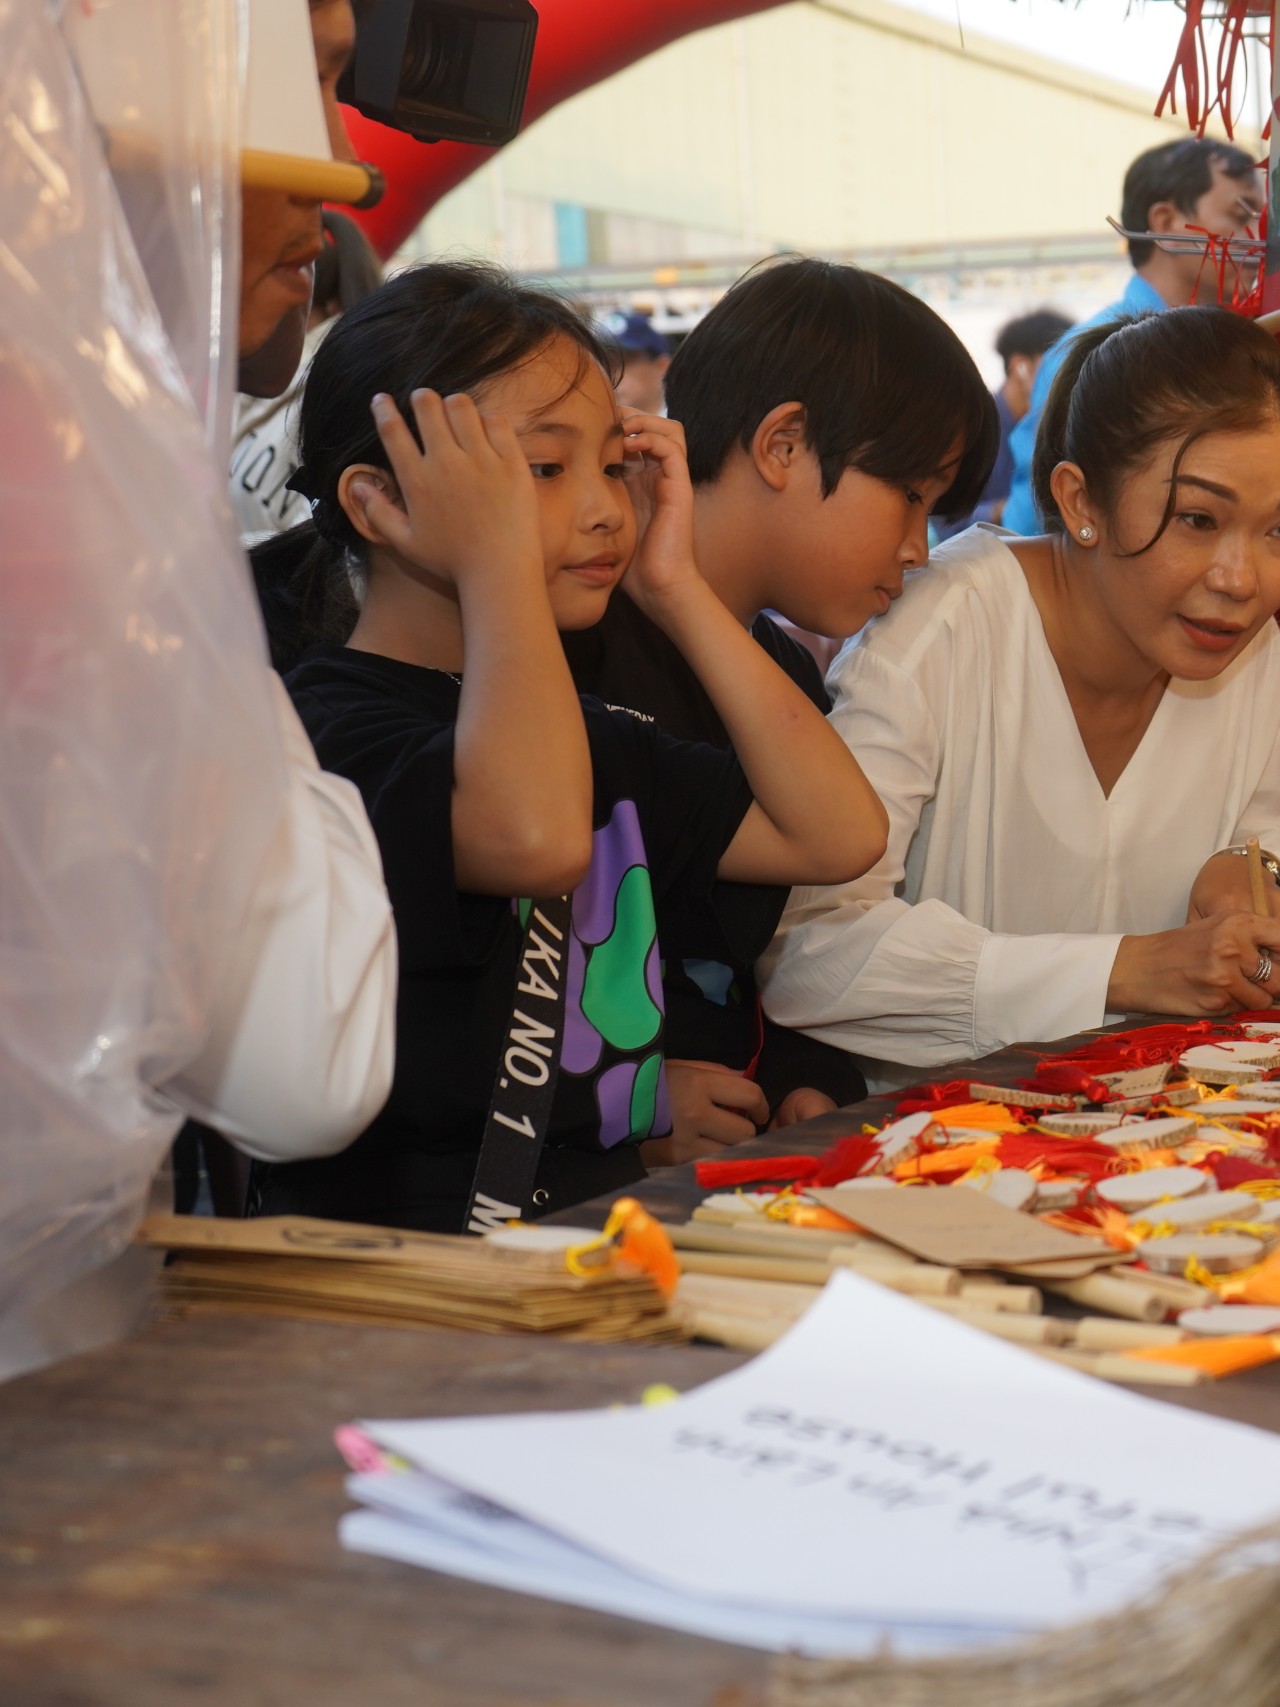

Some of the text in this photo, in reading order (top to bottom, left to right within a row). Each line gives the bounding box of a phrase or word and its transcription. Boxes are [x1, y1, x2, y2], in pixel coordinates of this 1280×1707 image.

[517, 895, 567, 1000] IKA
[500, 1009, 556, 1088] NO.
[493, 1110, 537, 1139] 1
